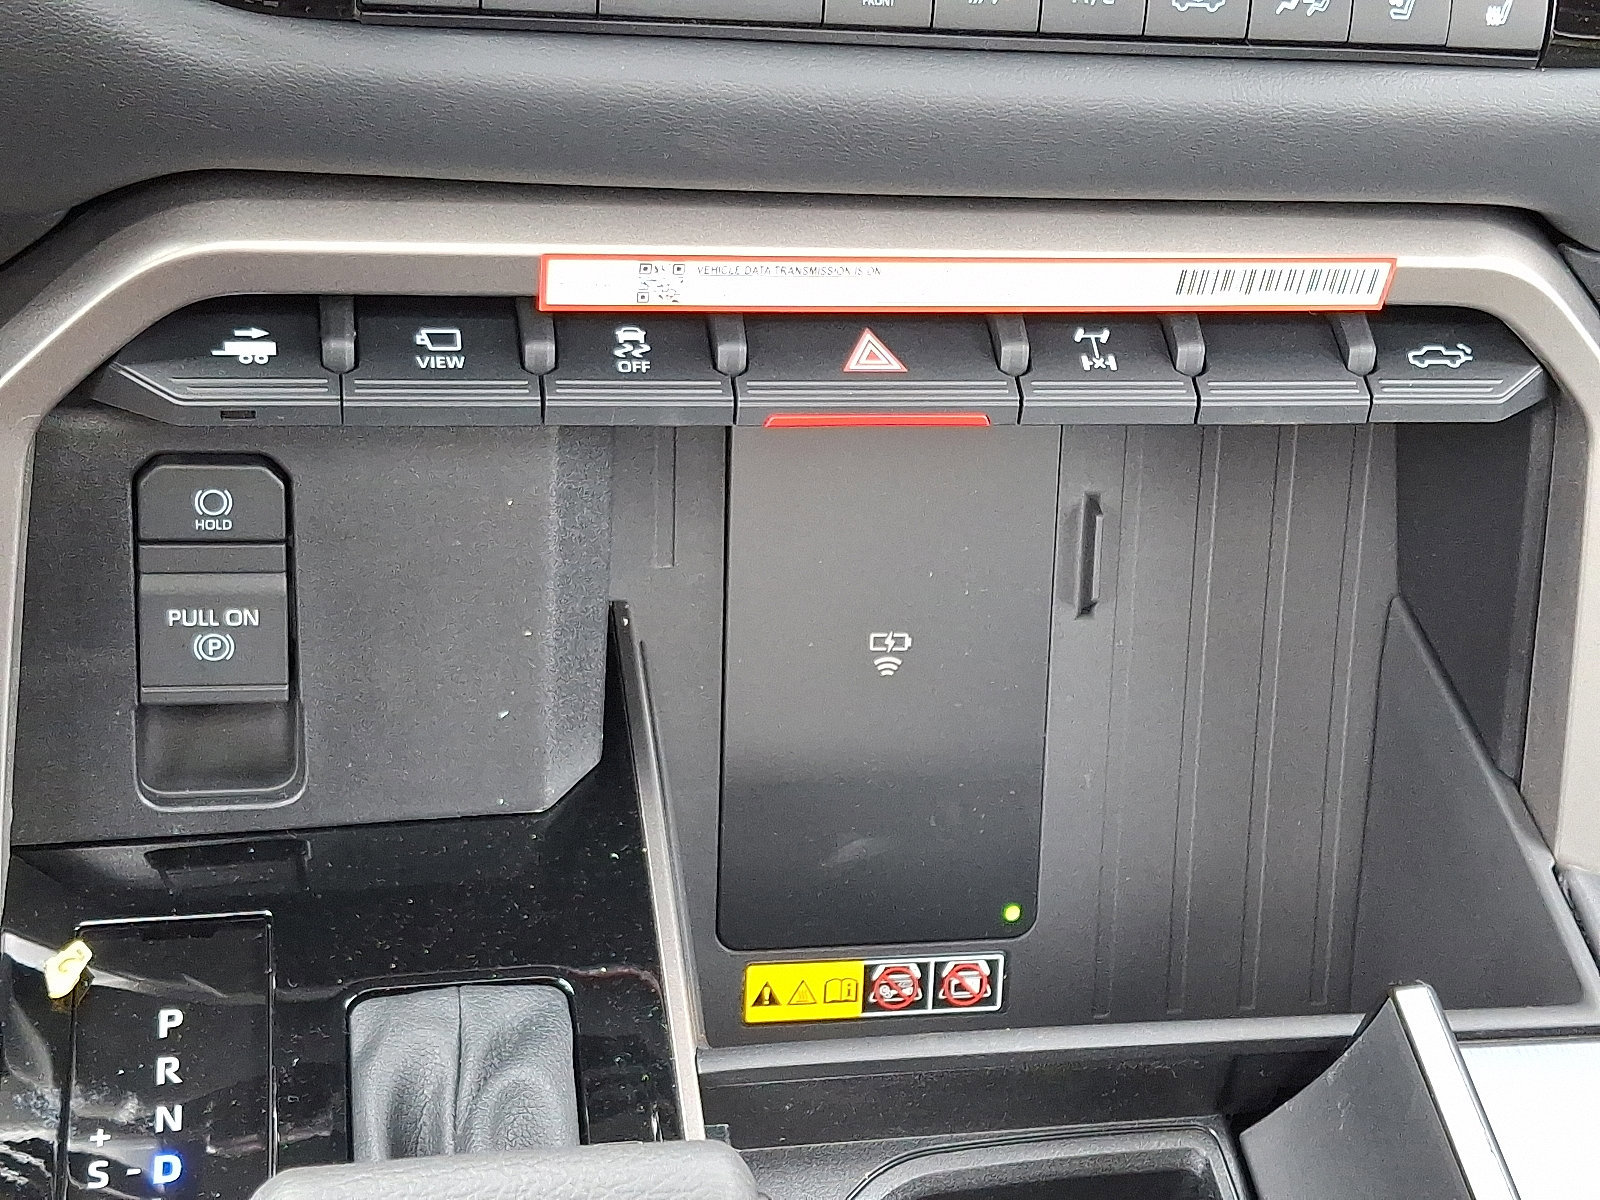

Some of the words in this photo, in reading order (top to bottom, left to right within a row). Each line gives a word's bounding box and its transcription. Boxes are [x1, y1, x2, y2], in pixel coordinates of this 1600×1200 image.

[697, 264, 740, 276] VEHICLE
[744, 265, 771, 276] DATA
[775, 265, 850, 276] TRANSMISSION
[854, 266, 863, 276] IS
[866, 267, 881, 276] ON
[415, 355, 466, 369] VIEW
[617, 360, 651, 373] OFF
[195, 519, 233, 531] HOLD
[168, 609, 219, 627] PULL
[224, 609, 260, 627] ON
[158, 1008, 184, 1039] P
[155, 1056, 184, 1086] R
[154, 1104, 183, 1133] N
[86, 1160, 110, 1189] S
[152, 1154, 183, 1185] D
